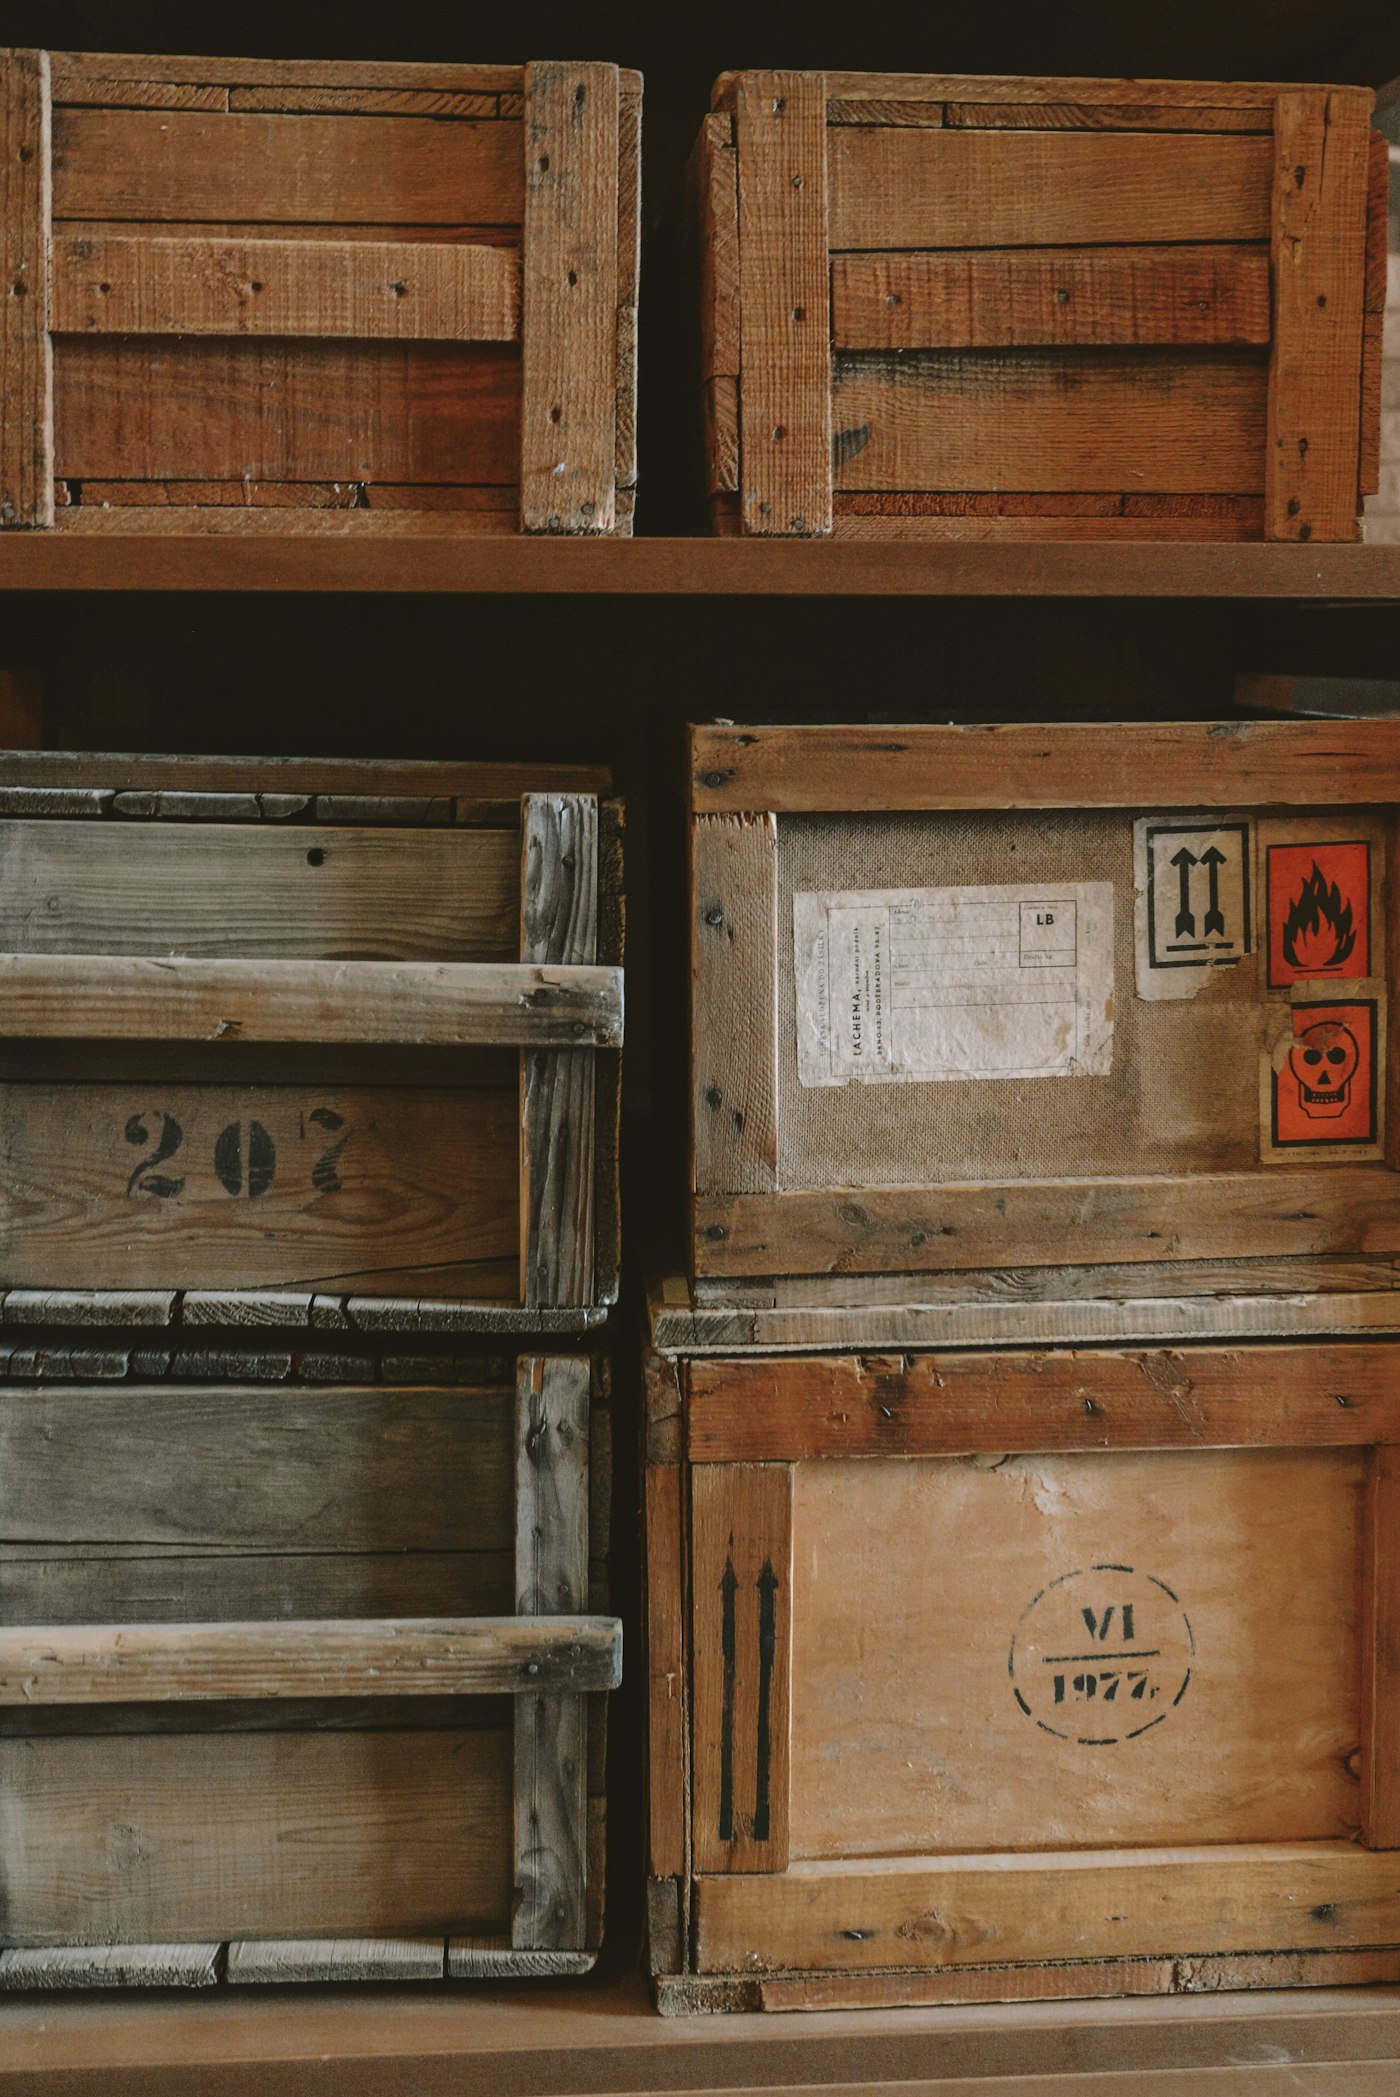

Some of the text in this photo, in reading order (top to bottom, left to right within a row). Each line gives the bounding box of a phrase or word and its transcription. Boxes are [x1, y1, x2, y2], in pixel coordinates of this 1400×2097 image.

[1036, 913, 1055, 926] LB
[852, 989, 862, 1056] LACHEMA,
[125, 1107, 350, 1198] 207
[1081, 1603, 1134, 1641] VI
